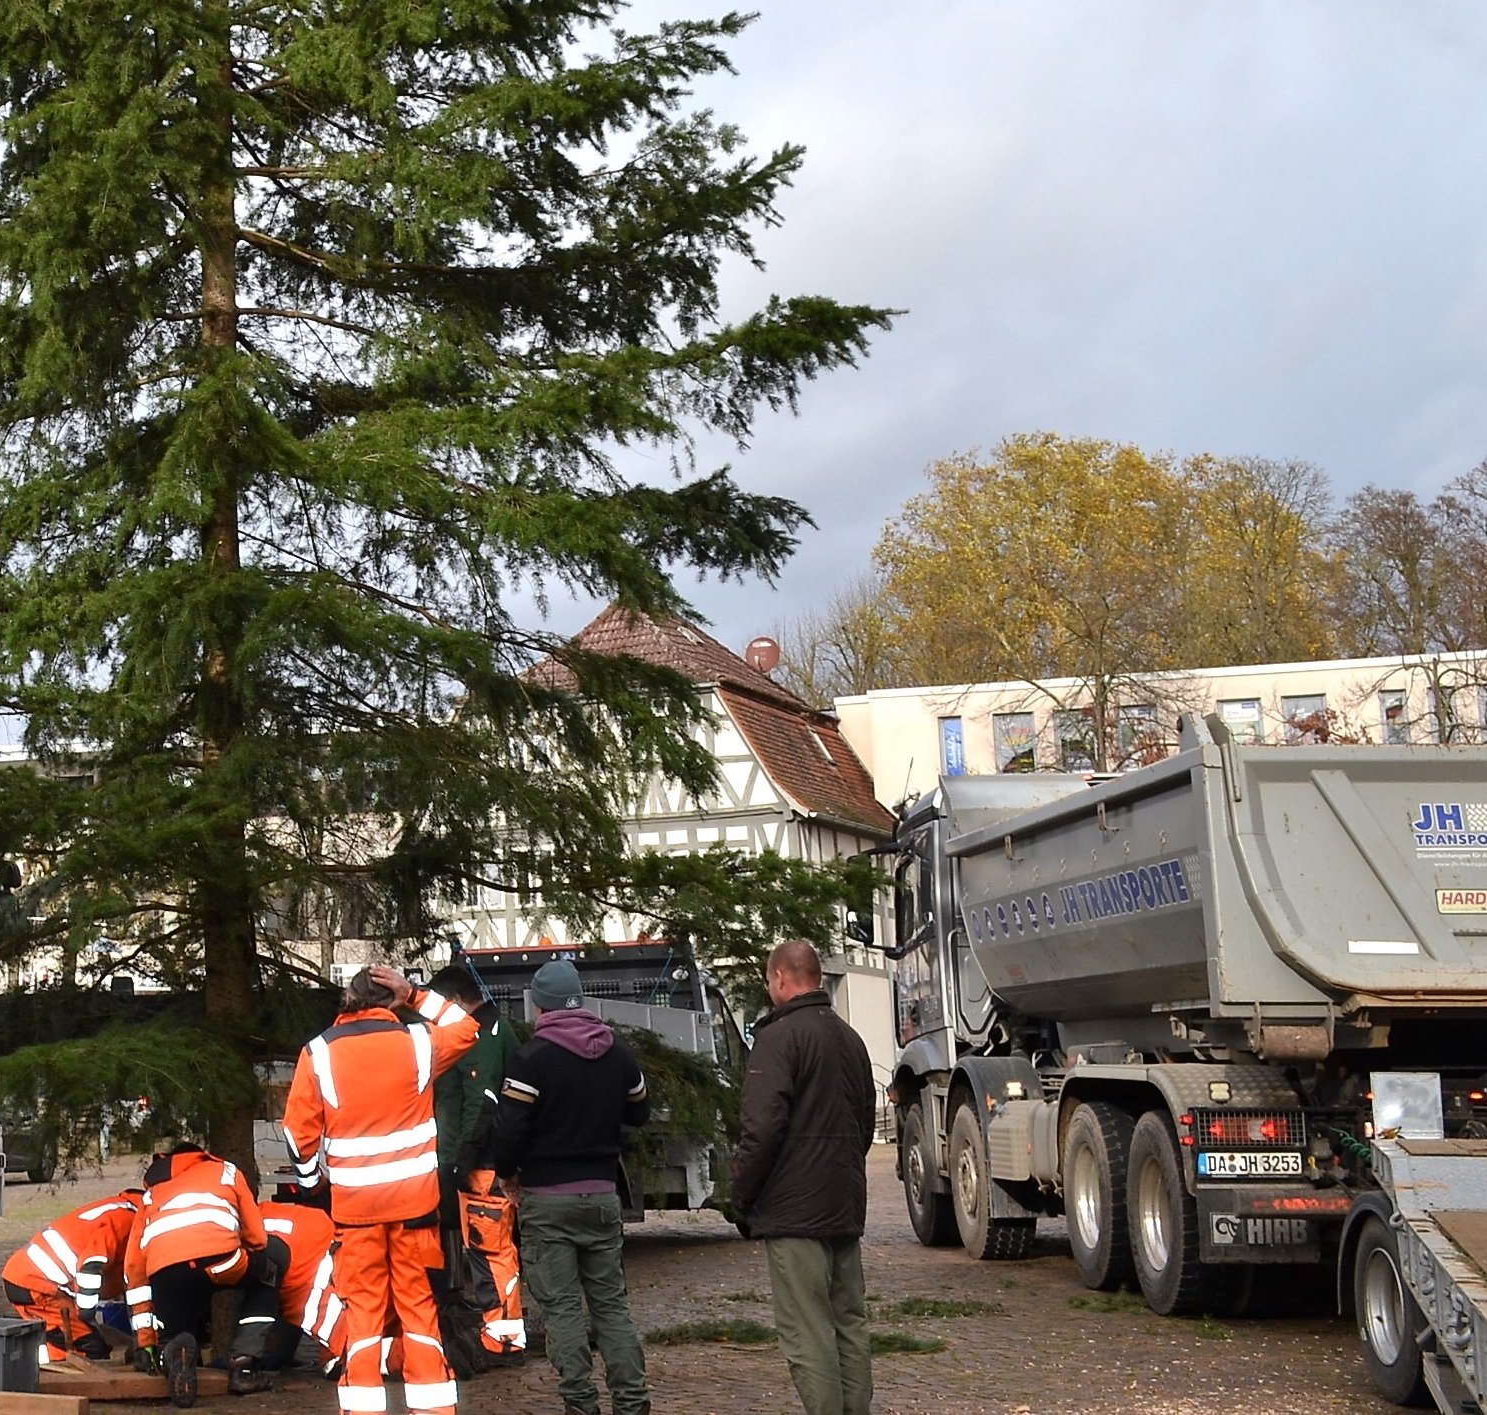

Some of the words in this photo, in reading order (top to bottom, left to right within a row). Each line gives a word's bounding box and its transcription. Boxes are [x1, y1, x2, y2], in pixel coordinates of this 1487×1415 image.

[1412, 803, 1464, 832] JH
[1415, 833, 1487, 846] TRANSPO
[1058, 885, 1081, 926] JH
[1078, 858, 1190, 922] TRANSPORTE
[1441, 892, 1487, 905] HARD
[1208, 1155, 1227, 1172] DA
[1239, 1155, 1258, 1172] JH
[1263, 1155, 1300, 1172] 3253
[1247, 1218, 1307, 1245] HIAB
